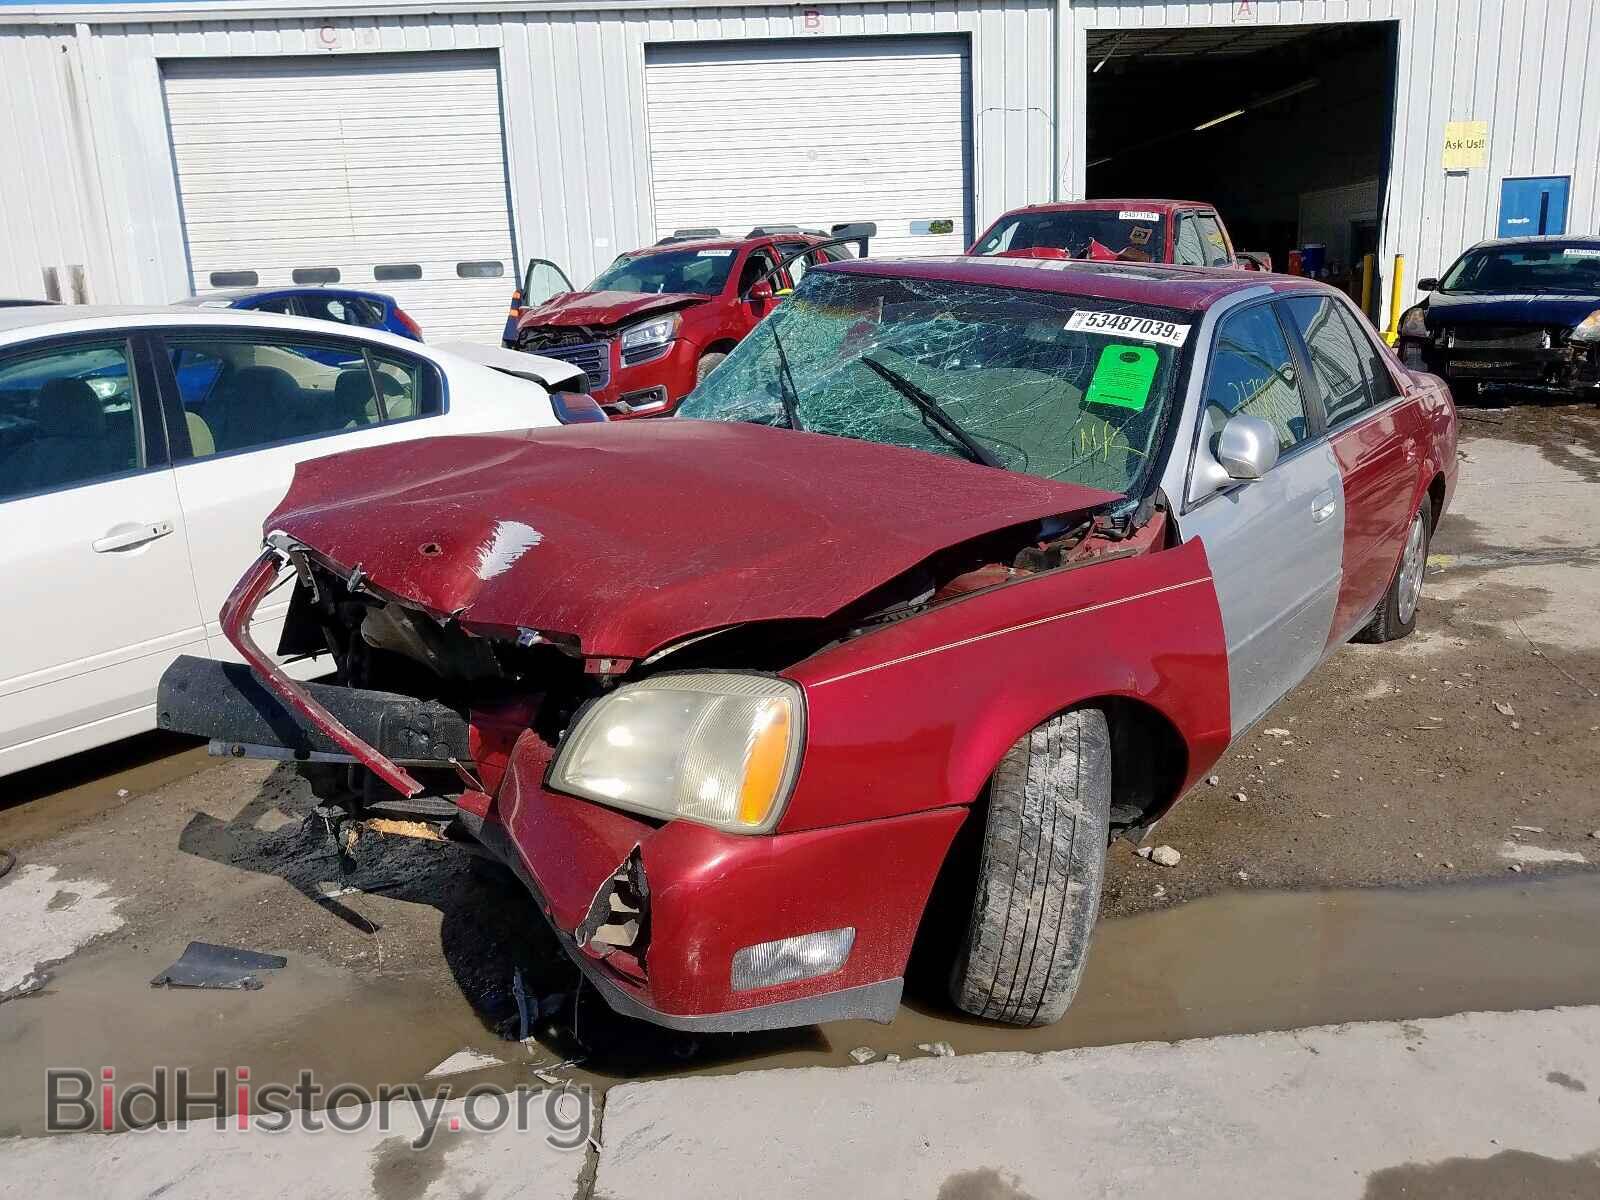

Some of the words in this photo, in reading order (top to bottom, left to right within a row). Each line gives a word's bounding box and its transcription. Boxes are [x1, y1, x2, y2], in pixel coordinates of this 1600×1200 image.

[804, 11, 821, 28] B
[320, 26, 336, 43] C
[1445, 140, 1463, 149] Ask
[1085, 312, 1176, 338] 53487039
